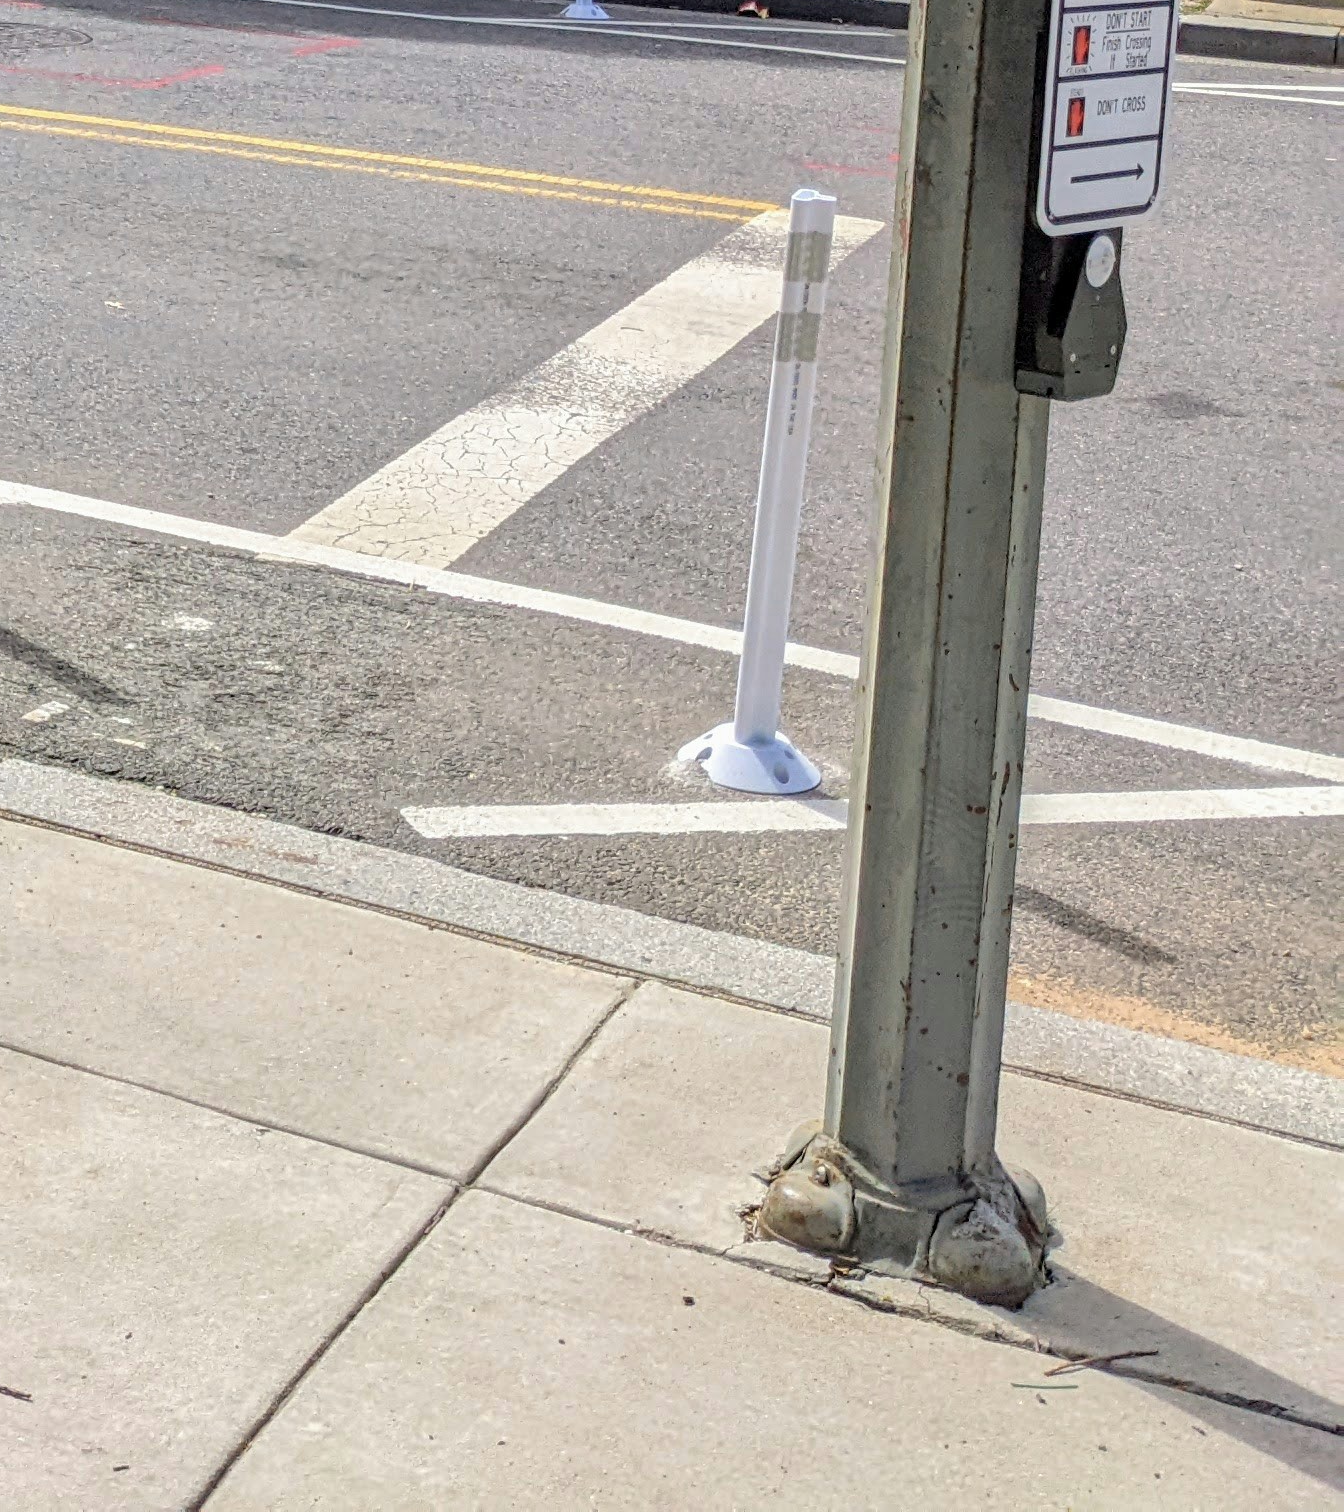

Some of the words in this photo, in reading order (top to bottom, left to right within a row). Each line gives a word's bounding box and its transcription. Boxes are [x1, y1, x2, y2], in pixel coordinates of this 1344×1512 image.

[1106, 12, 1128, 30] DON'T
[1131, 10, 1152, 29] START
[1102, 35, 1122, 52] Finish
[1125, 33, 1152, 54] Crossing
[1109, 54, 1116, 70] If
[1125, 52, 1149, 69] Started
[1097, 98, 1119, 116] DON'T
[1121, 95, 1146, 113] CROSS
